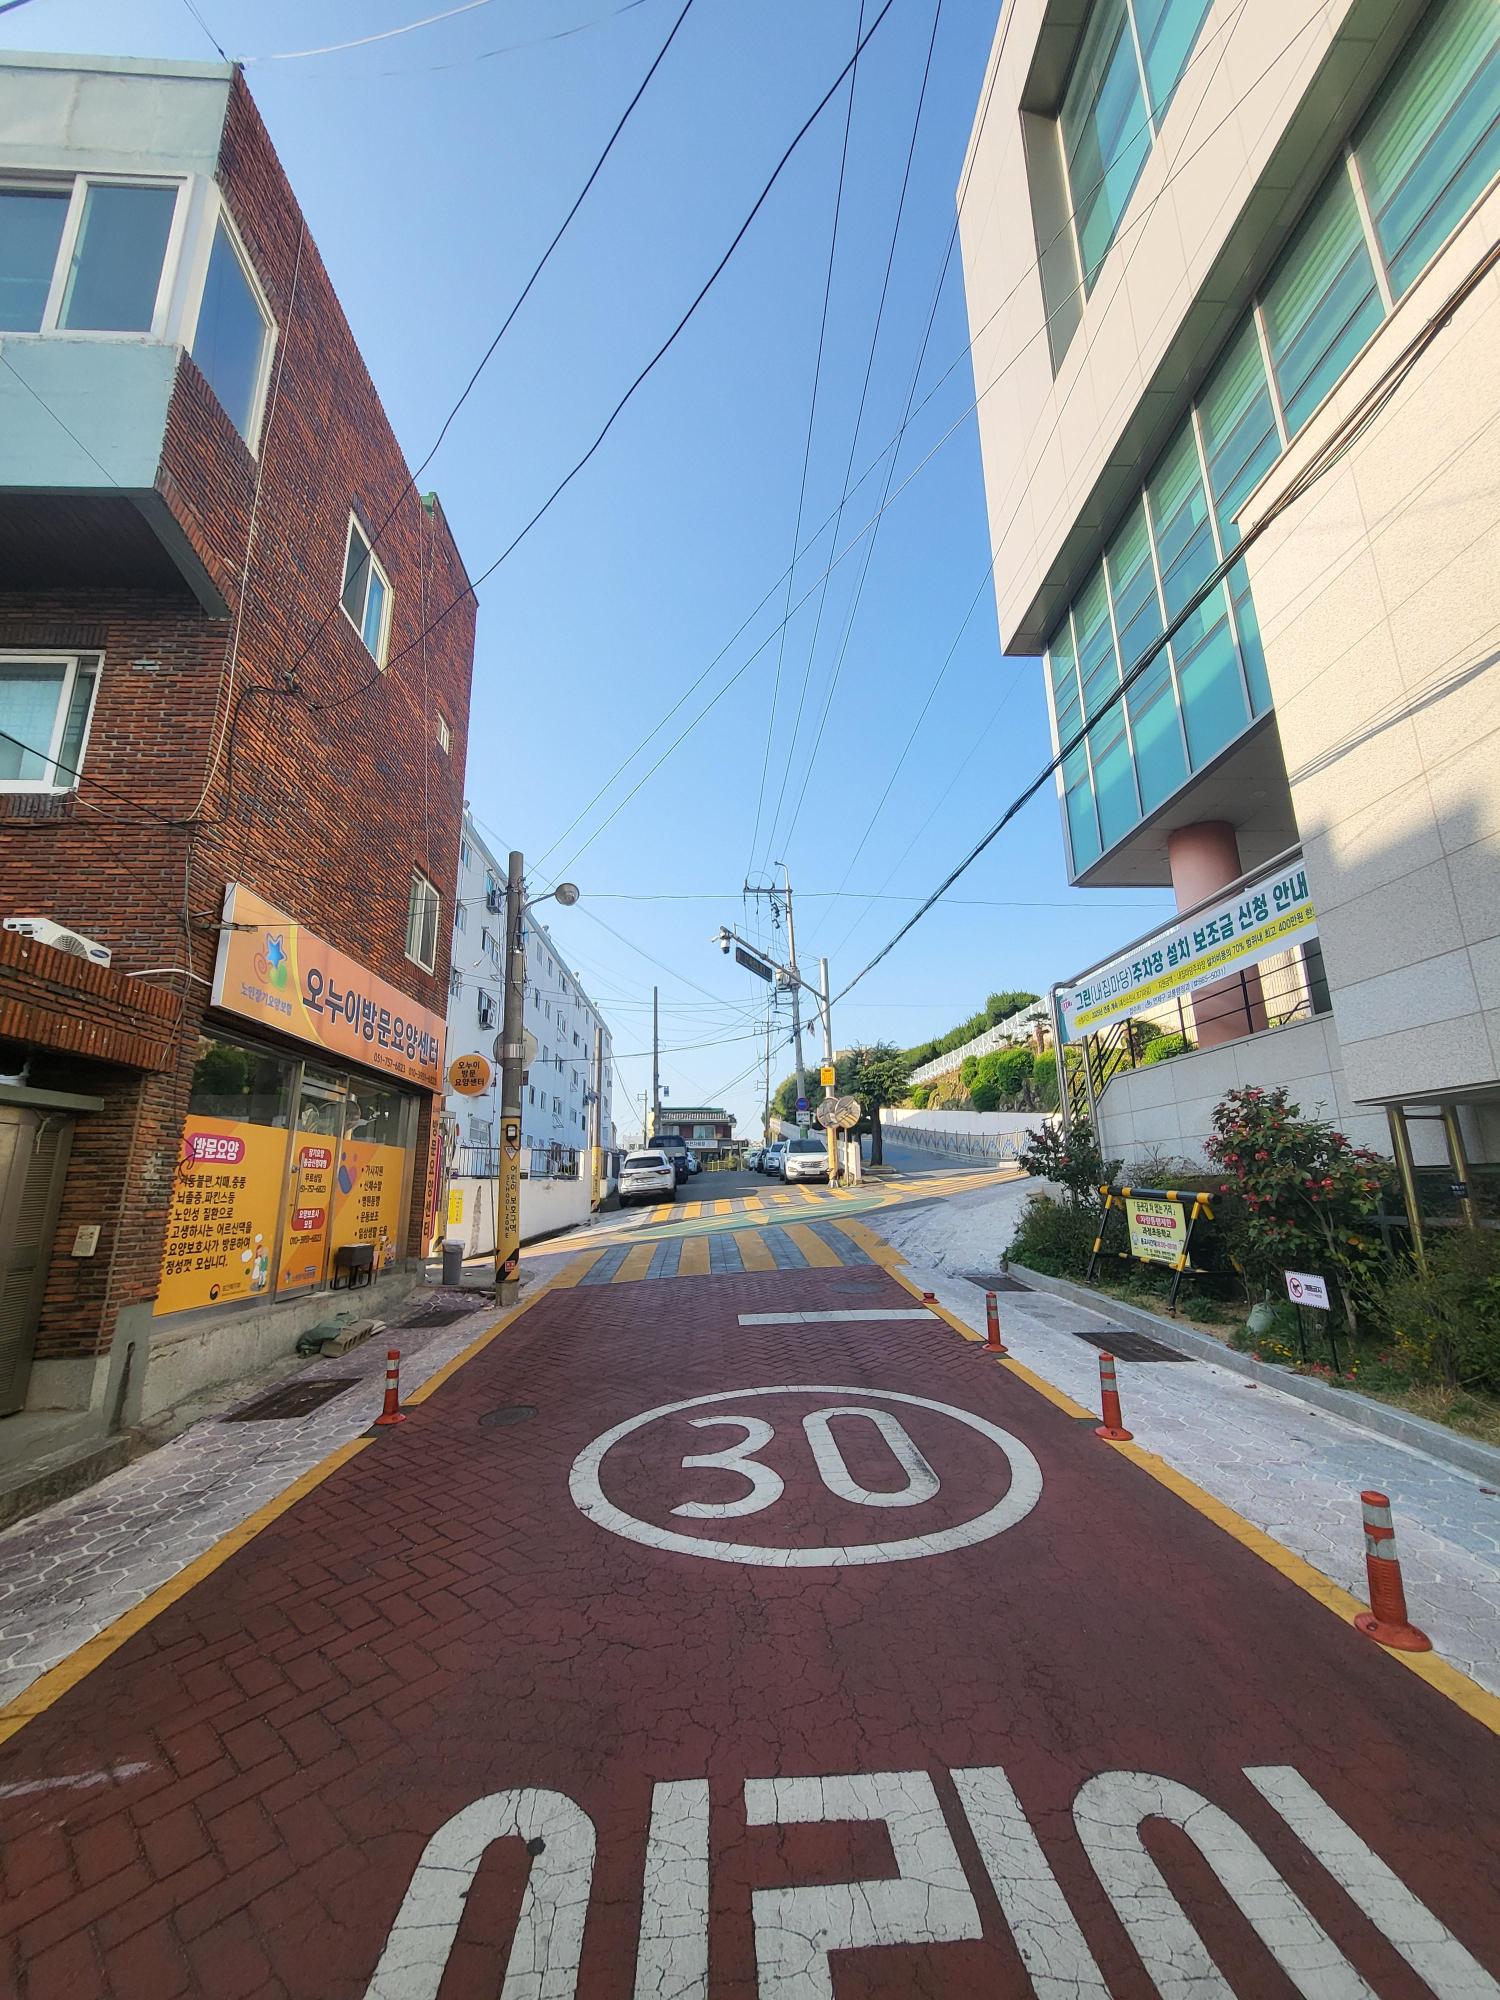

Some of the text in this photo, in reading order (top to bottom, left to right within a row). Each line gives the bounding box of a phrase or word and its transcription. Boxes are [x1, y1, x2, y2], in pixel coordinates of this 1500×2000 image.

[1075, 870, 1309, 1011] 그린(내집마당)주차장 설치 보조금 신청 안내
[1232, 942, 1245, 955] 70%
[1265, 926, 1277, 939] 최고
[1279, 911, 1305, 932] 400만원
[302, 968, 440, 1070] 오누이방문요양센터
[457, 1060, 481, 1070] 오누이
[461, 1069, 476, 1078] 방문
[454, 1078, 485, 1087] 요양센터
[193, 1136, 240, 1161] 방문요양
[510, 1165, 518, 1192] 어린이
[174, 1207, 234, 1222] 노인성 질환으로
[509, 1196, 518, 1234] 보호구역
[170, 1221, 253, 1239] 고생하시는 어르신댁을
[168, 1237, 251, 1256] 요양보호사가 방문하여
[166, 1254, 229, 1276] 정성껏 모십니다.
[669, 1407, 941, 1519] 30
